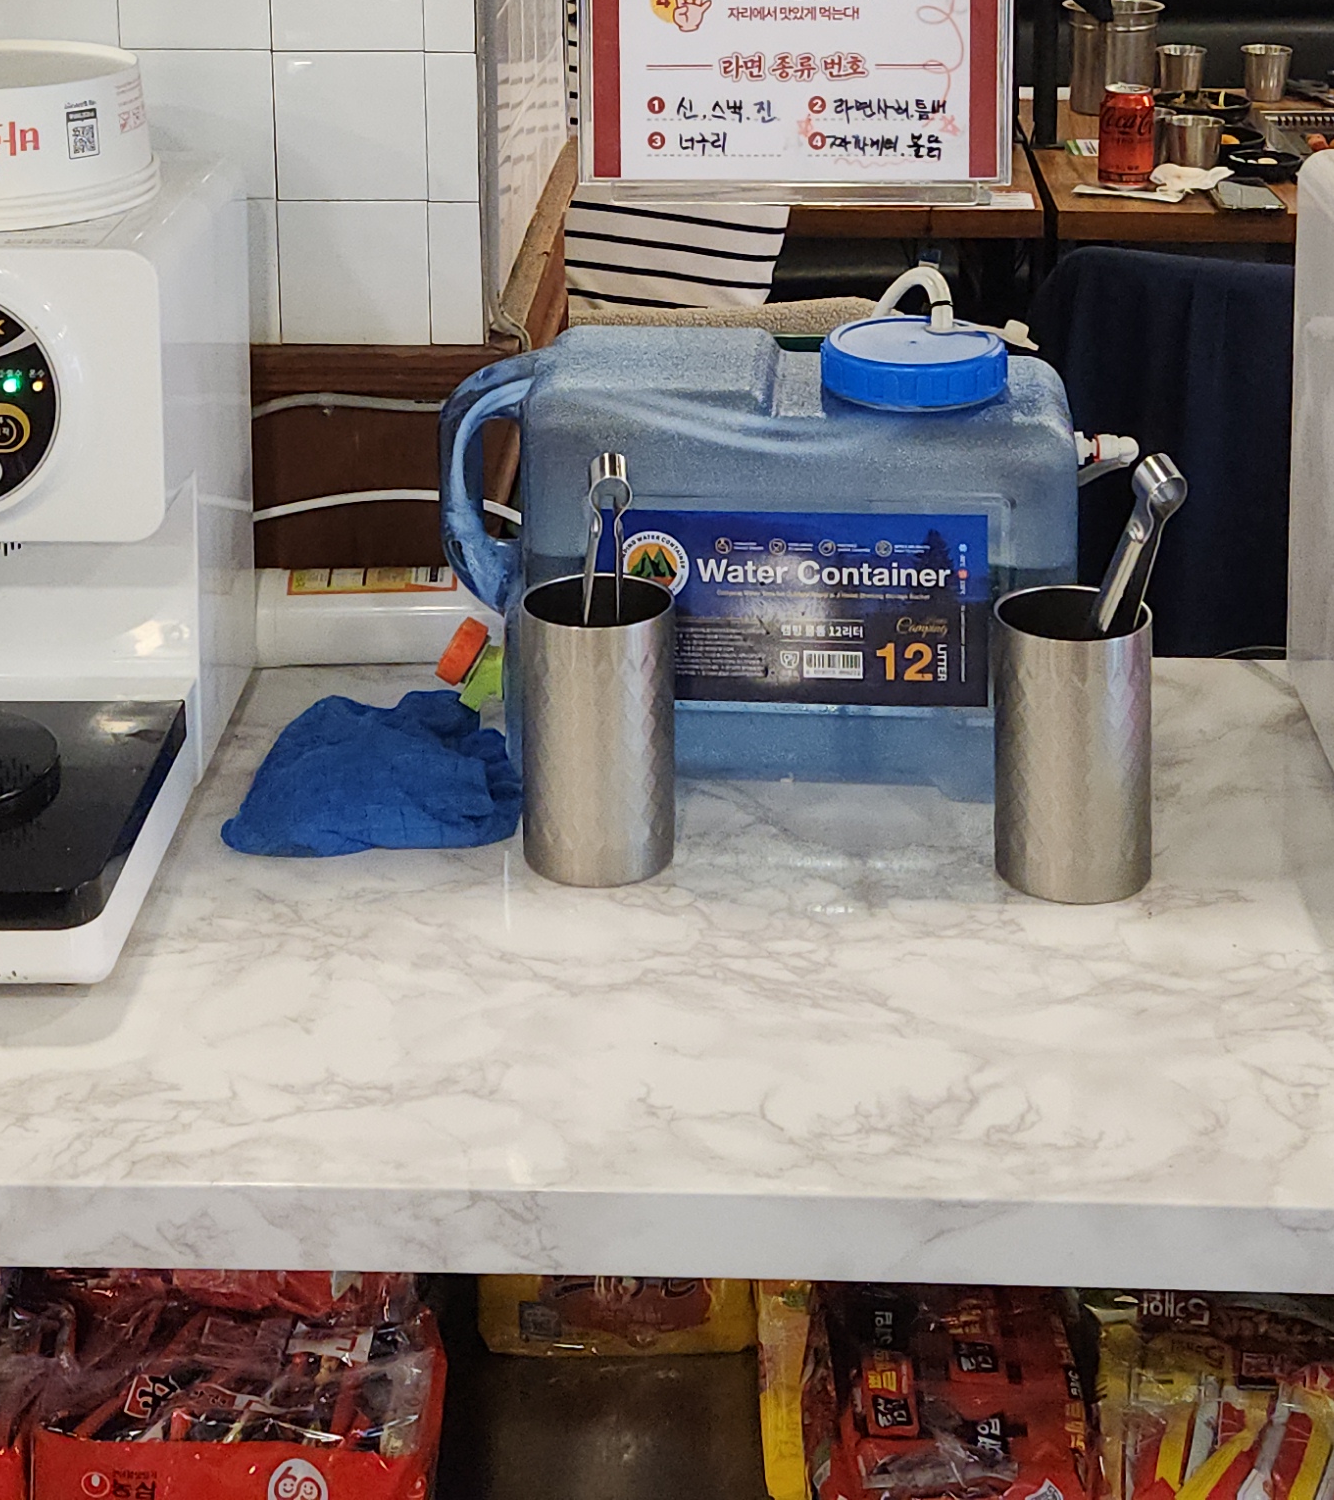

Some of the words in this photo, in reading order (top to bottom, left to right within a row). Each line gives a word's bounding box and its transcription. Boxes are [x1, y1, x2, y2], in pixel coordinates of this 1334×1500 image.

[728, 7, 777, 21] 자리에서
[780, 7, 817, 21] 맛있게
[819, 7, 859, 21] 먹는다!
[721, 54, 763, 80] 라면
[771, 54, 816, 80] 종류
[823, 54, 867, 80] 번호
[753, 99, 776, 123] 진
[679, 131, 727, 156] 너구리
[696, 558, 788, 584] Water
[797, 560, 952, 587] Container
[876, 642, 934, 682] 12
